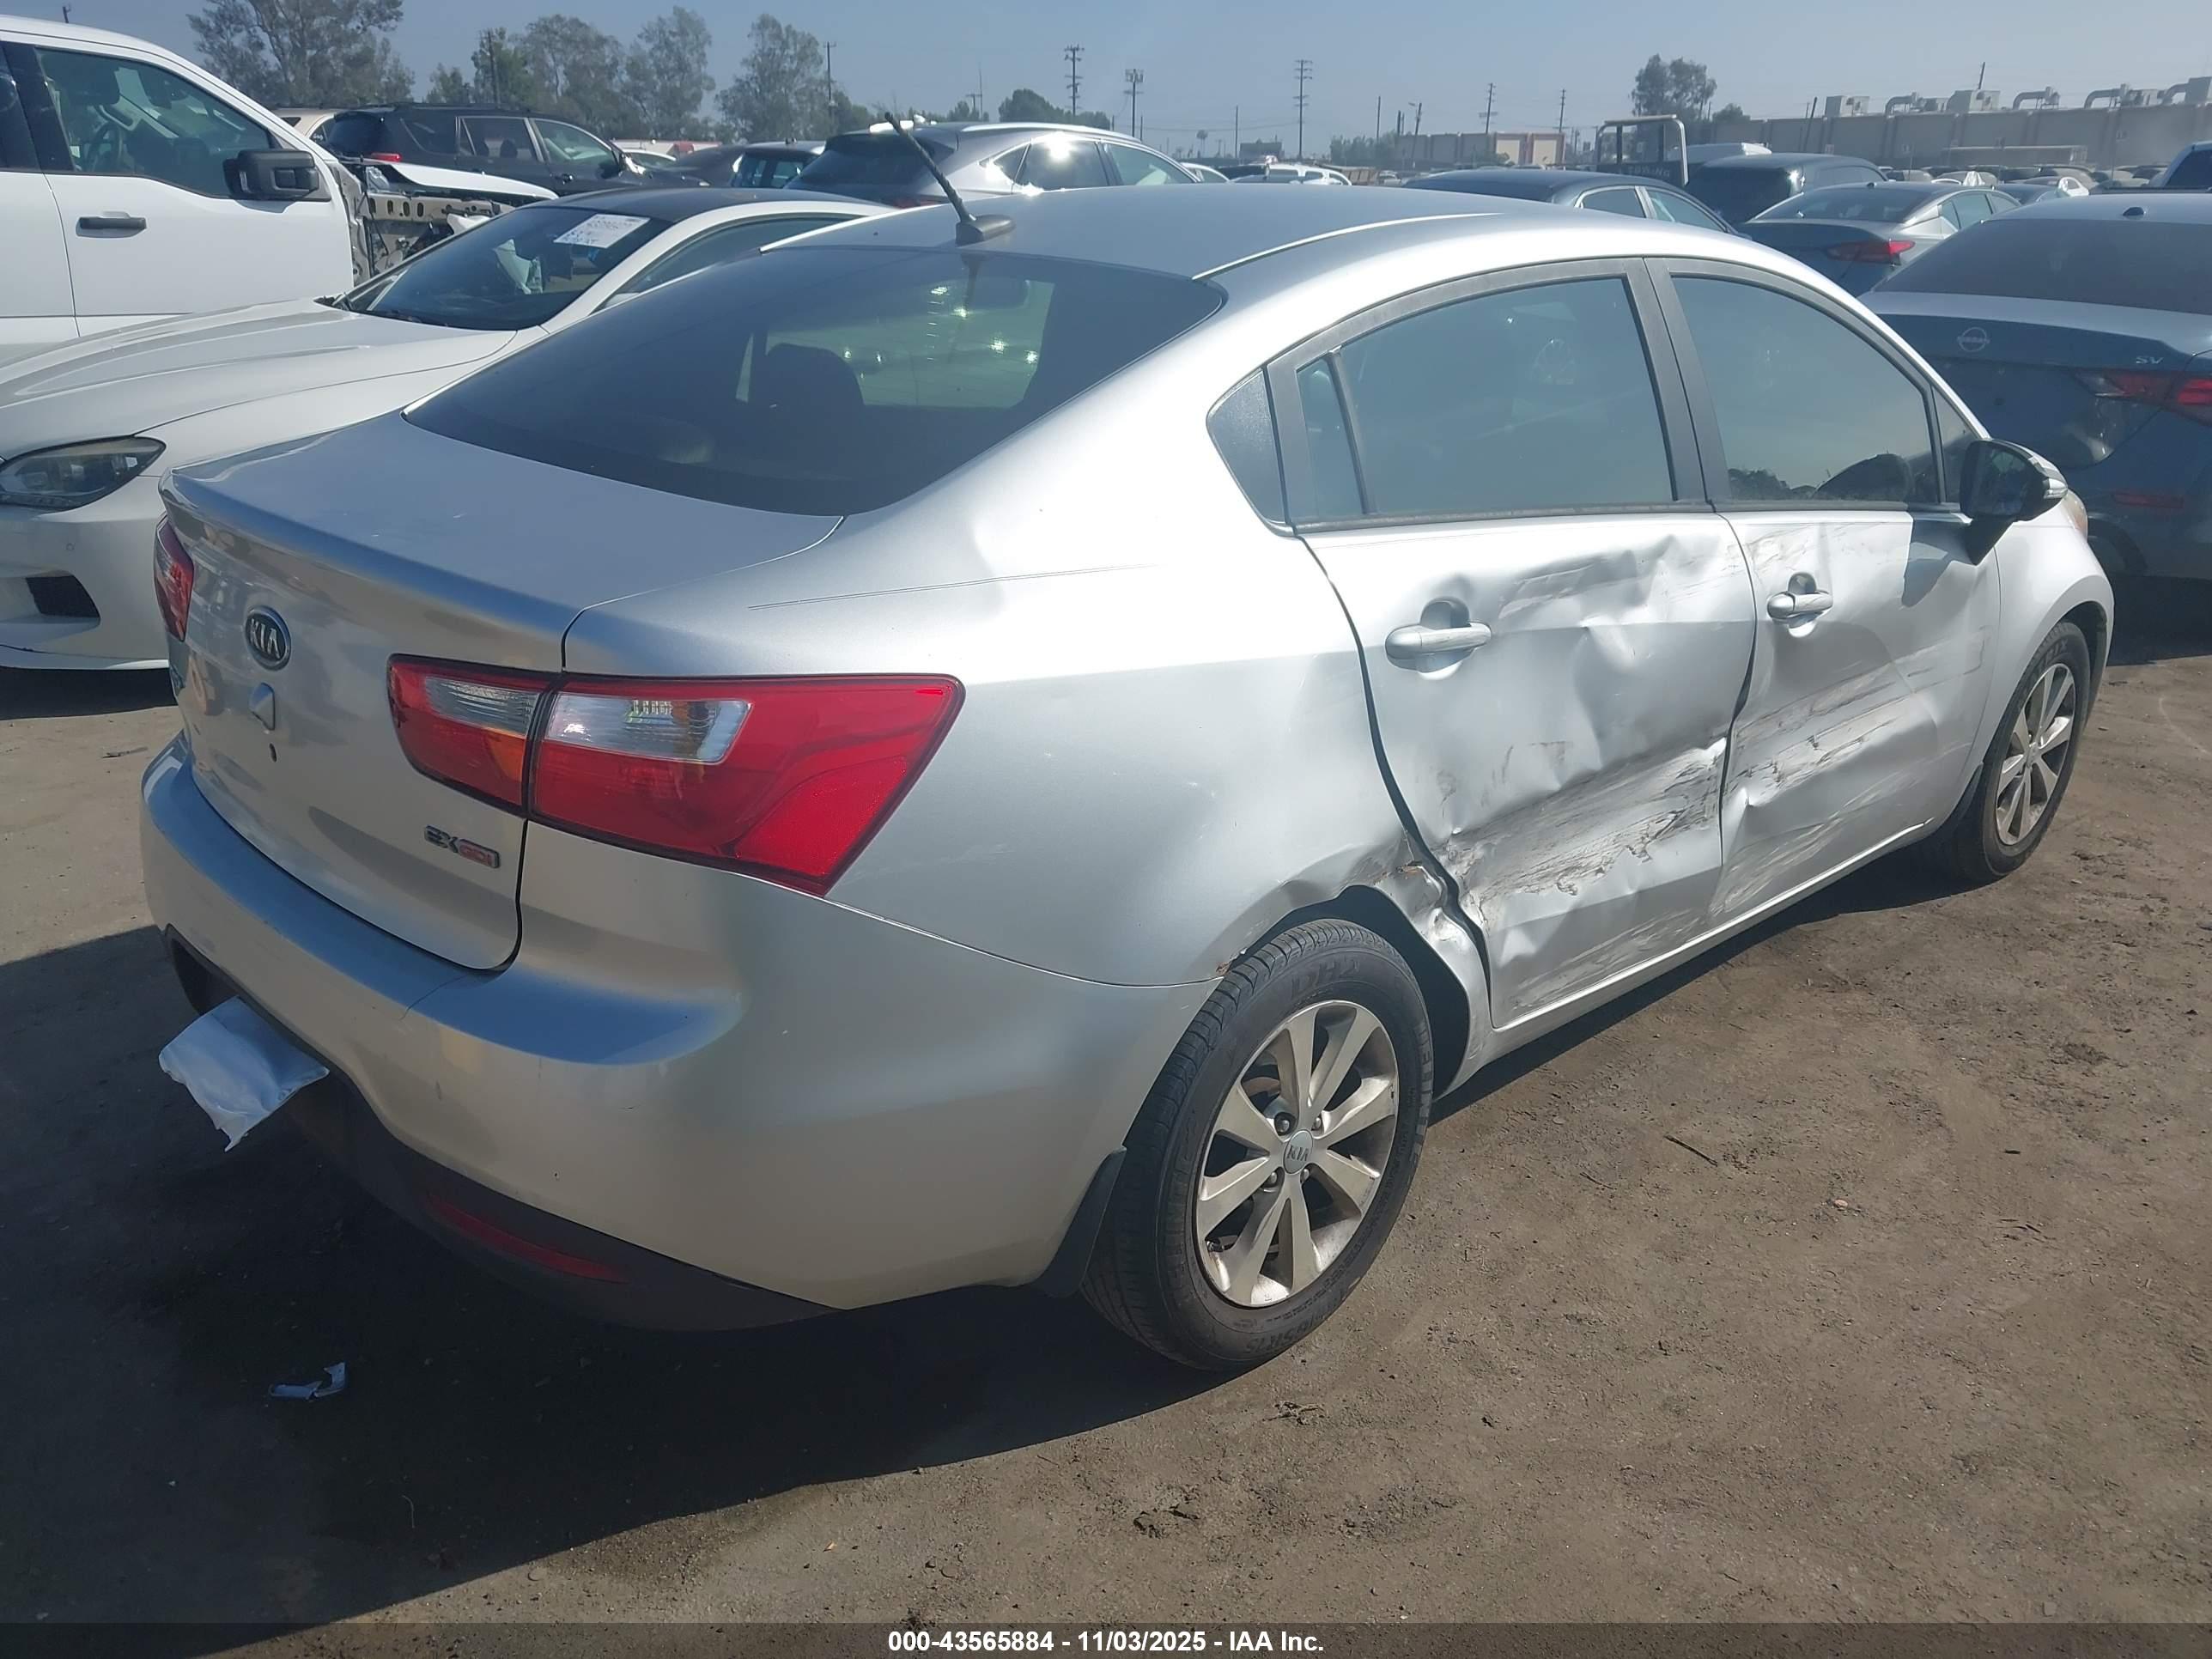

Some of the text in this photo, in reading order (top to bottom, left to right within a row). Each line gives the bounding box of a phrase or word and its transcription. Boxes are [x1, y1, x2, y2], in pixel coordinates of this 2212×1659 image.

[2136, 356, 2164, 364] SV
[250, 618, 281, 659] KIA
[1286, 1145, 1310, 1161] KIA
